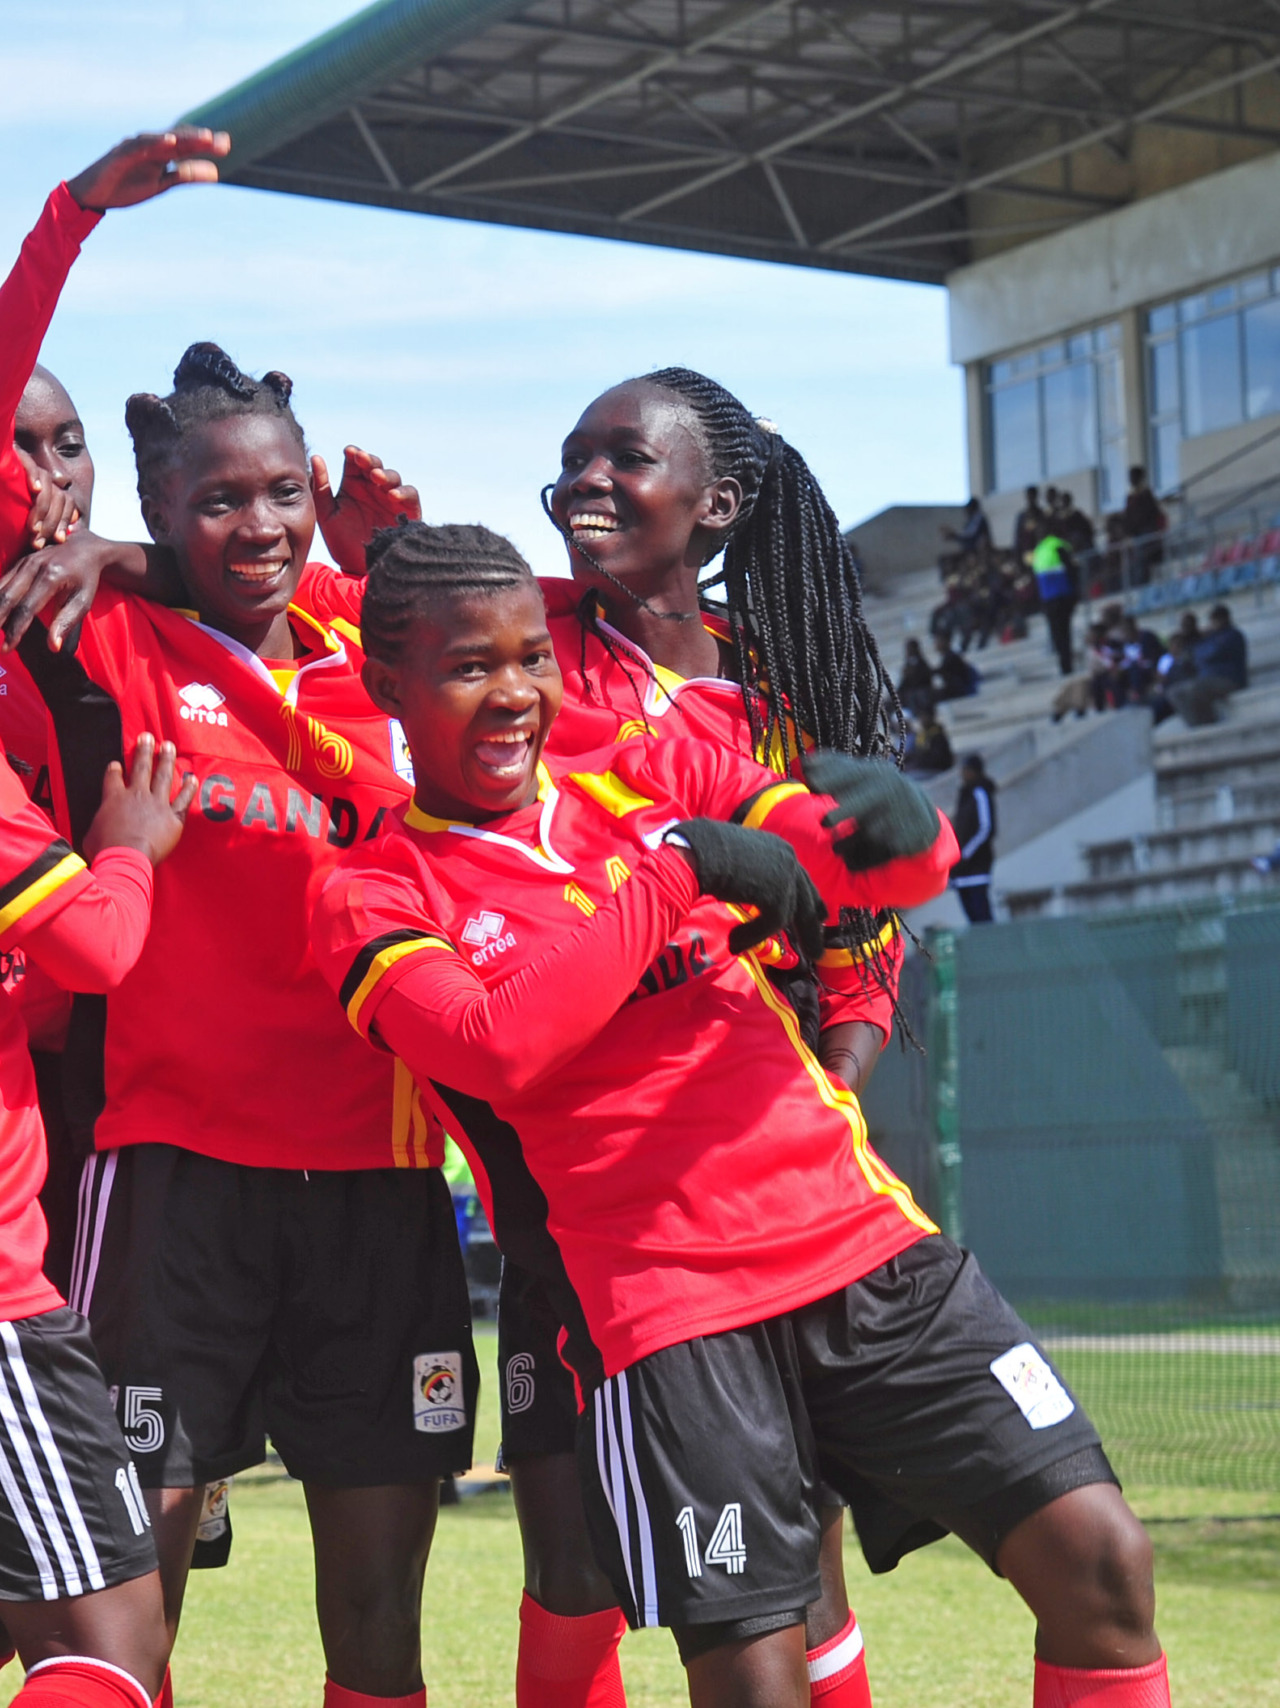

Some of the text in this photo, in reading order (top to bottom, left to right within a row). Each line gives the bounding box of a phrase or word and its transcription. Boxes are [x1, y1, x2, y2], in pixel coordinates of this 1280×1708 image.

[179, 705, 228, 727] errea
[182, 771, 388, 849] GAND
[472, 931, 517, 967] errea
[506, 1352, 535, 1415] 6
[108, 1385, 165, 1453] 5
[423, 1413, 460, 1427] FUFA
[675, 1503, 747, 1578] 14
